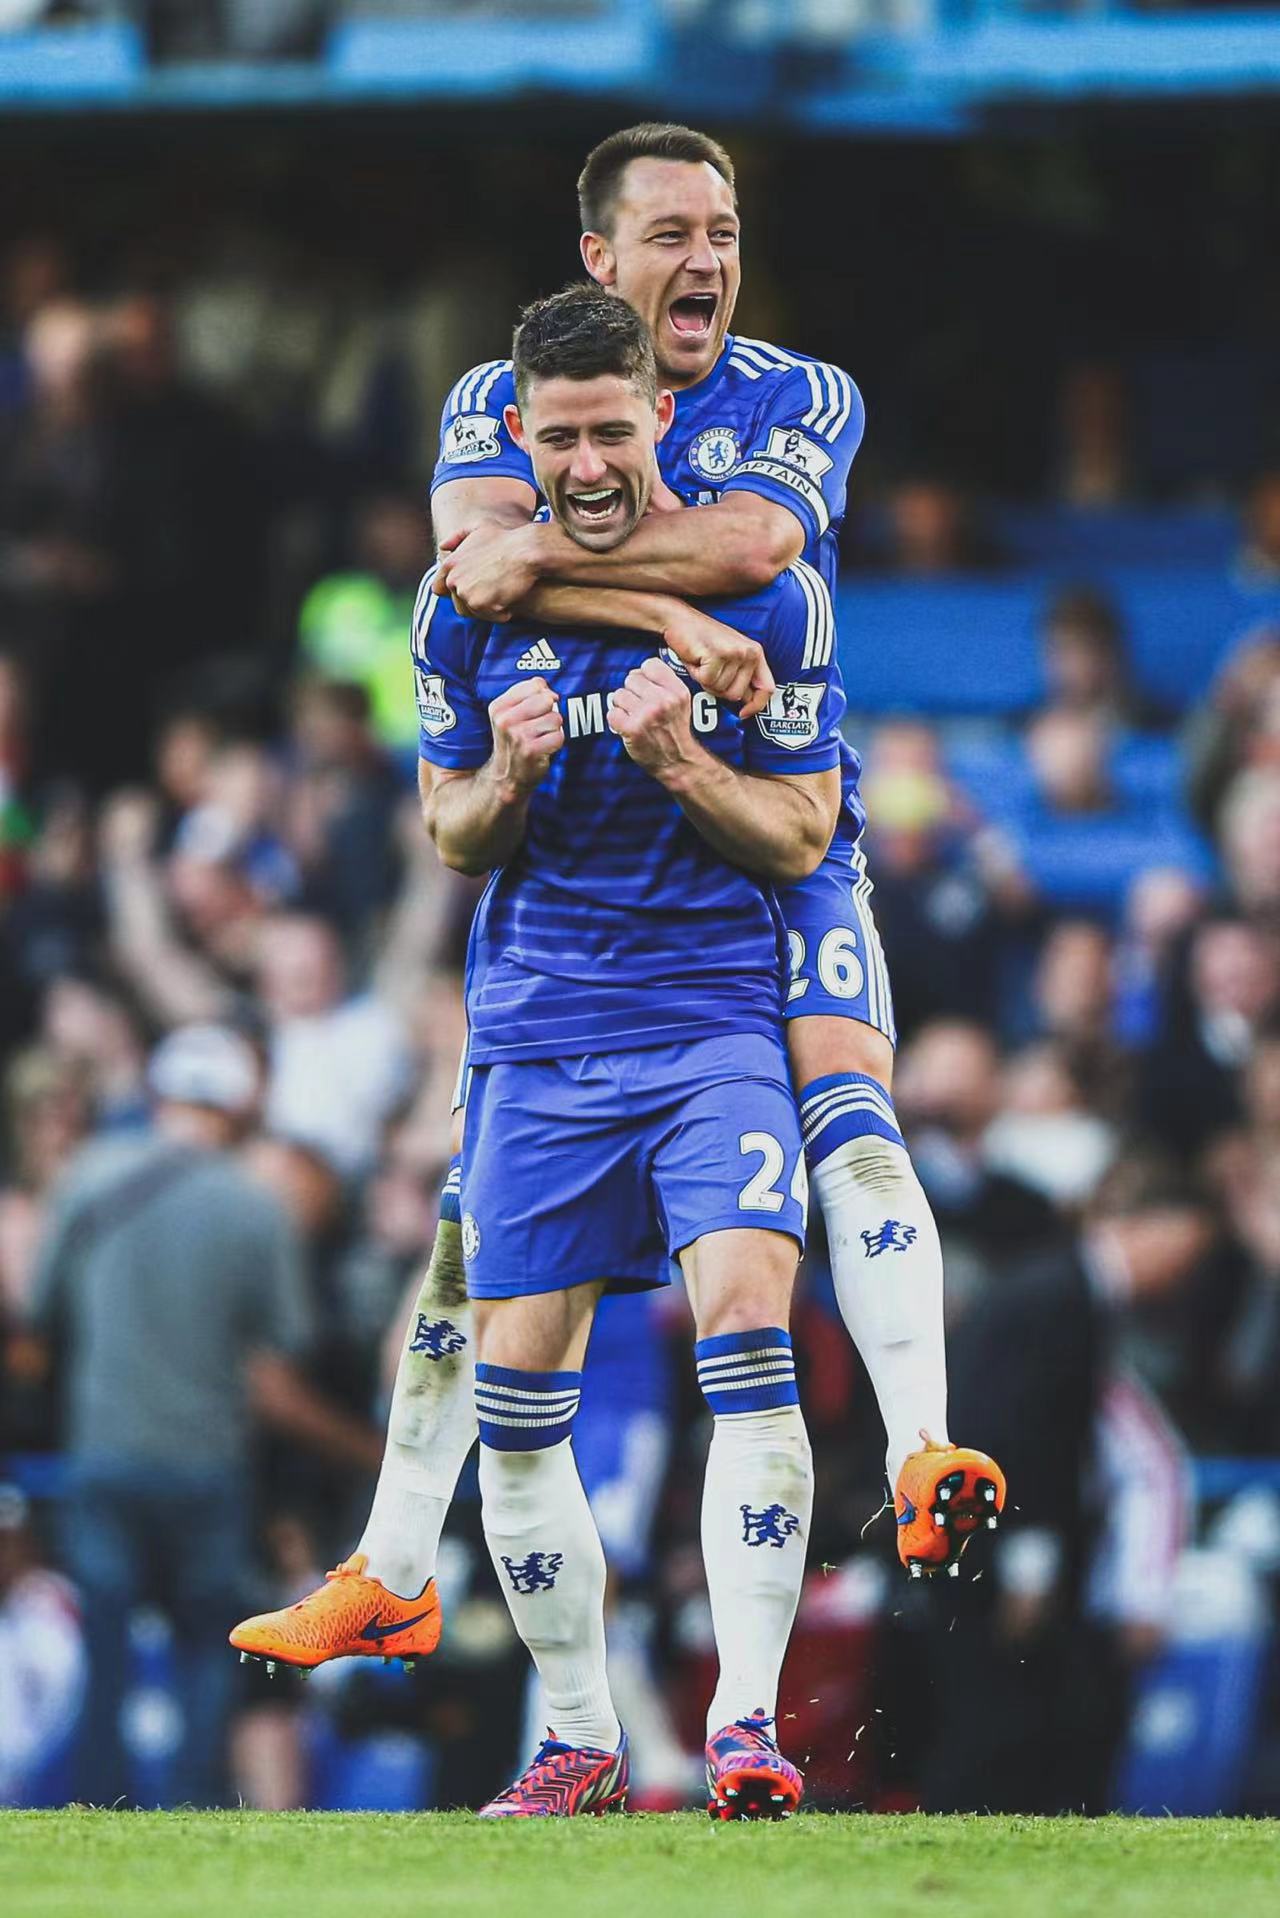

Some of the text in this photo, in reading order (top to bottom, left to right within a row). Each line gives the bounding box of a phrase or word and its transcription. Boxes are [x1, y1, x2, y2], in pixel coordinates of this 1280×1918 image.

[740, 462, 811, 495] APTAIN
[516, 657, 561, 670] adidas
[769, 721, 810, 730] BARCLAYS
